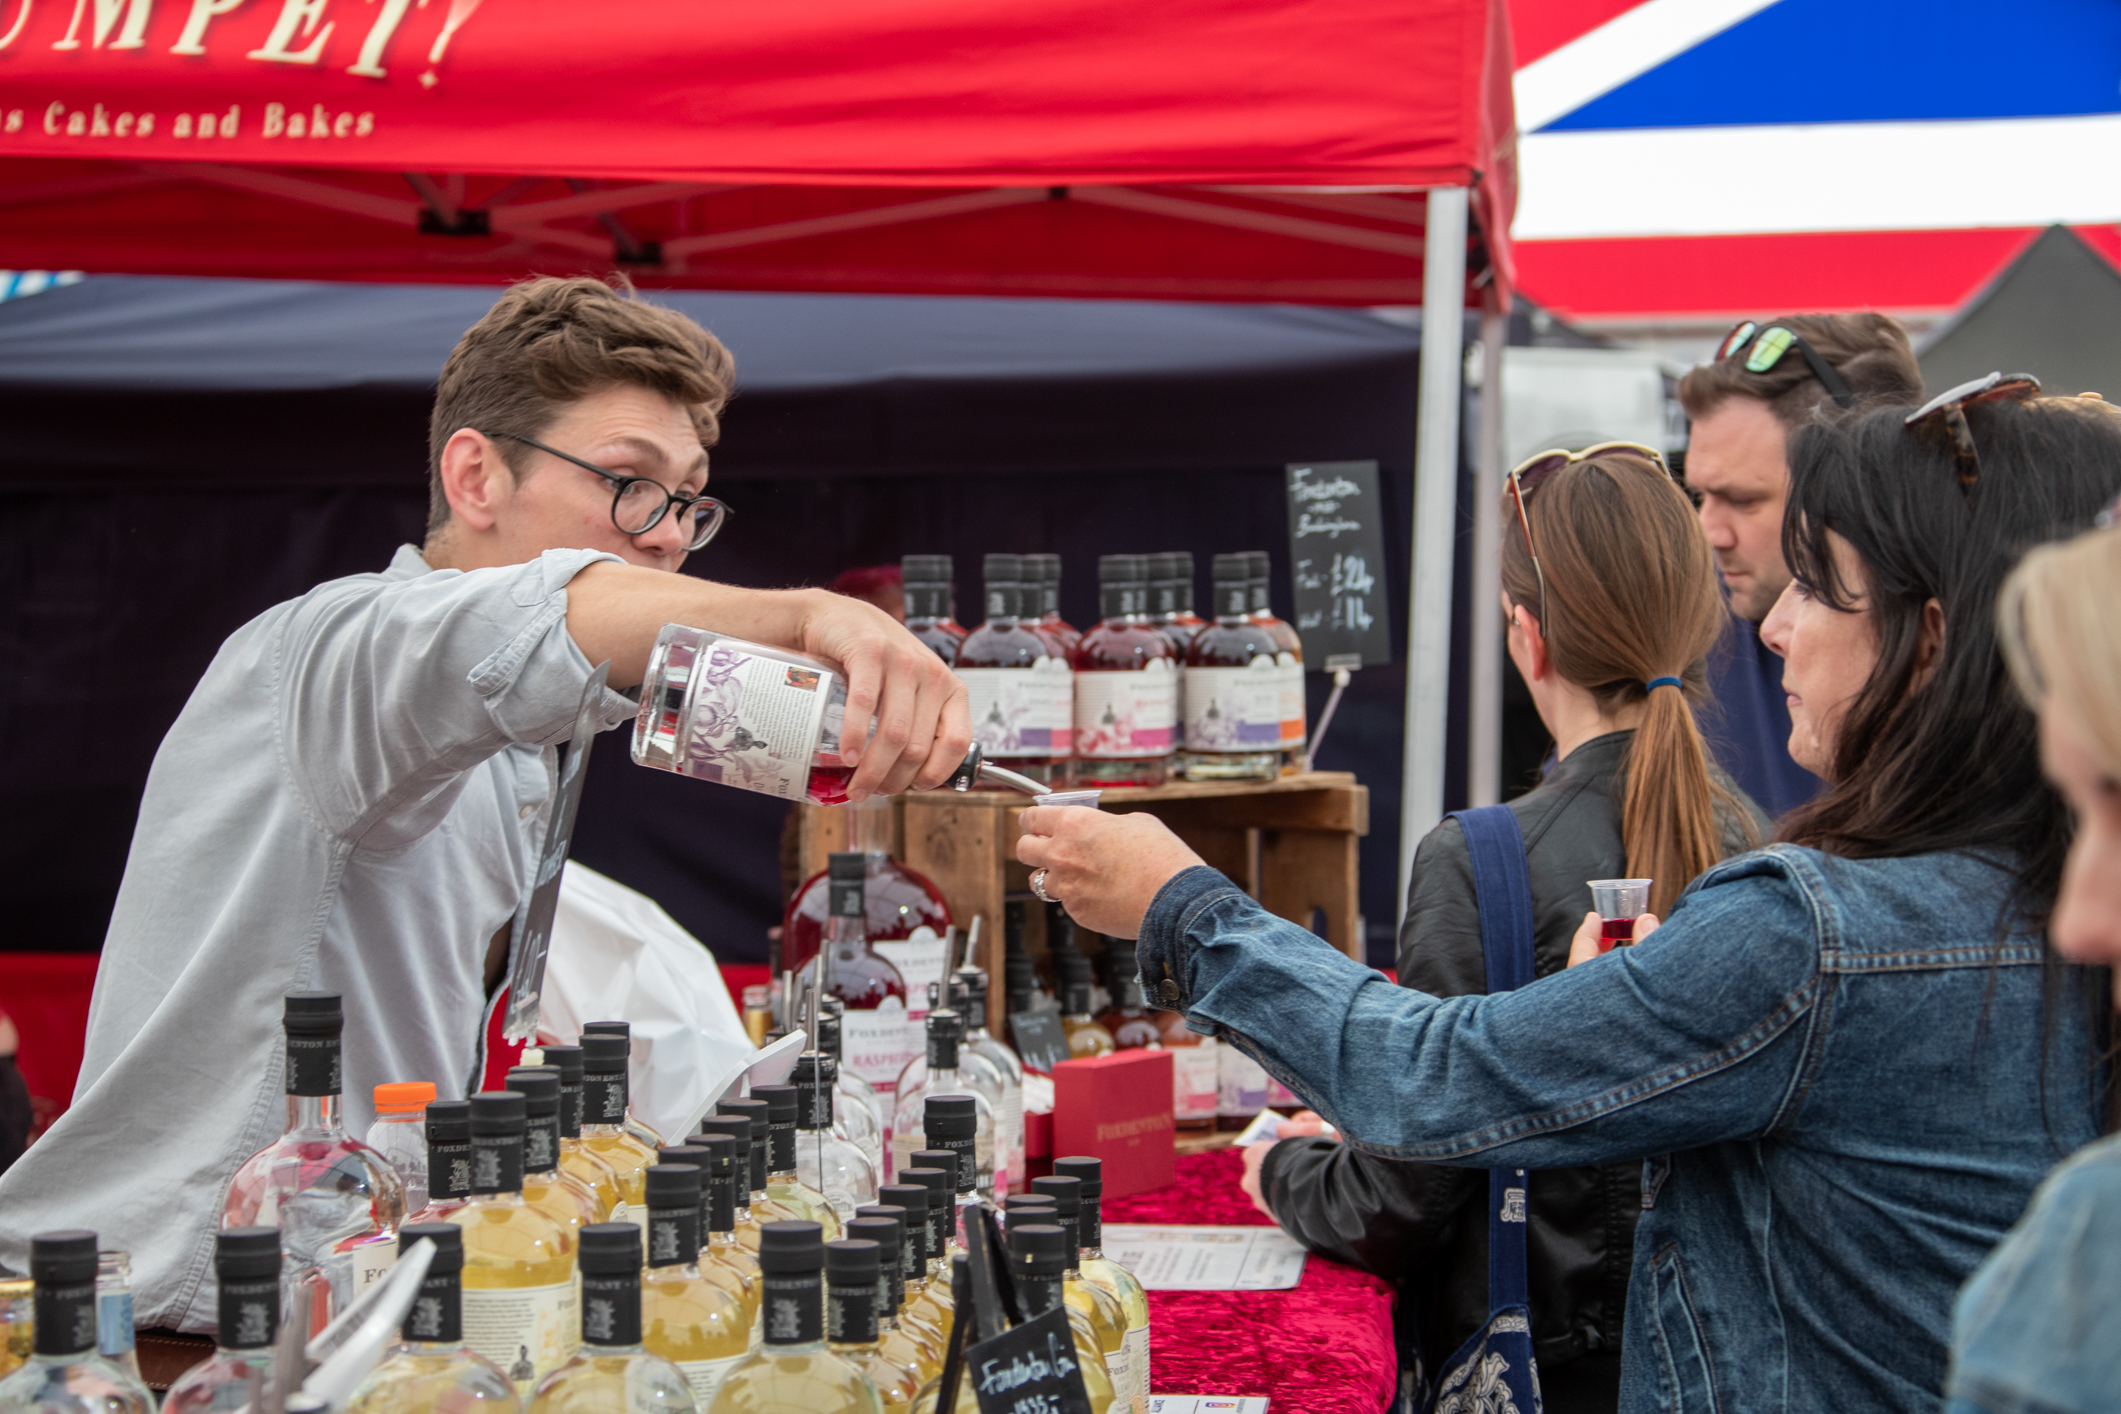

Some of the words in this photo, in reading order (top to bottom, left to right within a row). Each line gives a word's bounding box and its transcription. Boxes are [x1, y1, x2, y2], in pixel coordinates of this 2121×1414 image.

[43, 100, 156, 138] Cakes
[172, 103, 241, 139] and
[261, 101, 376, 139] Bakes
